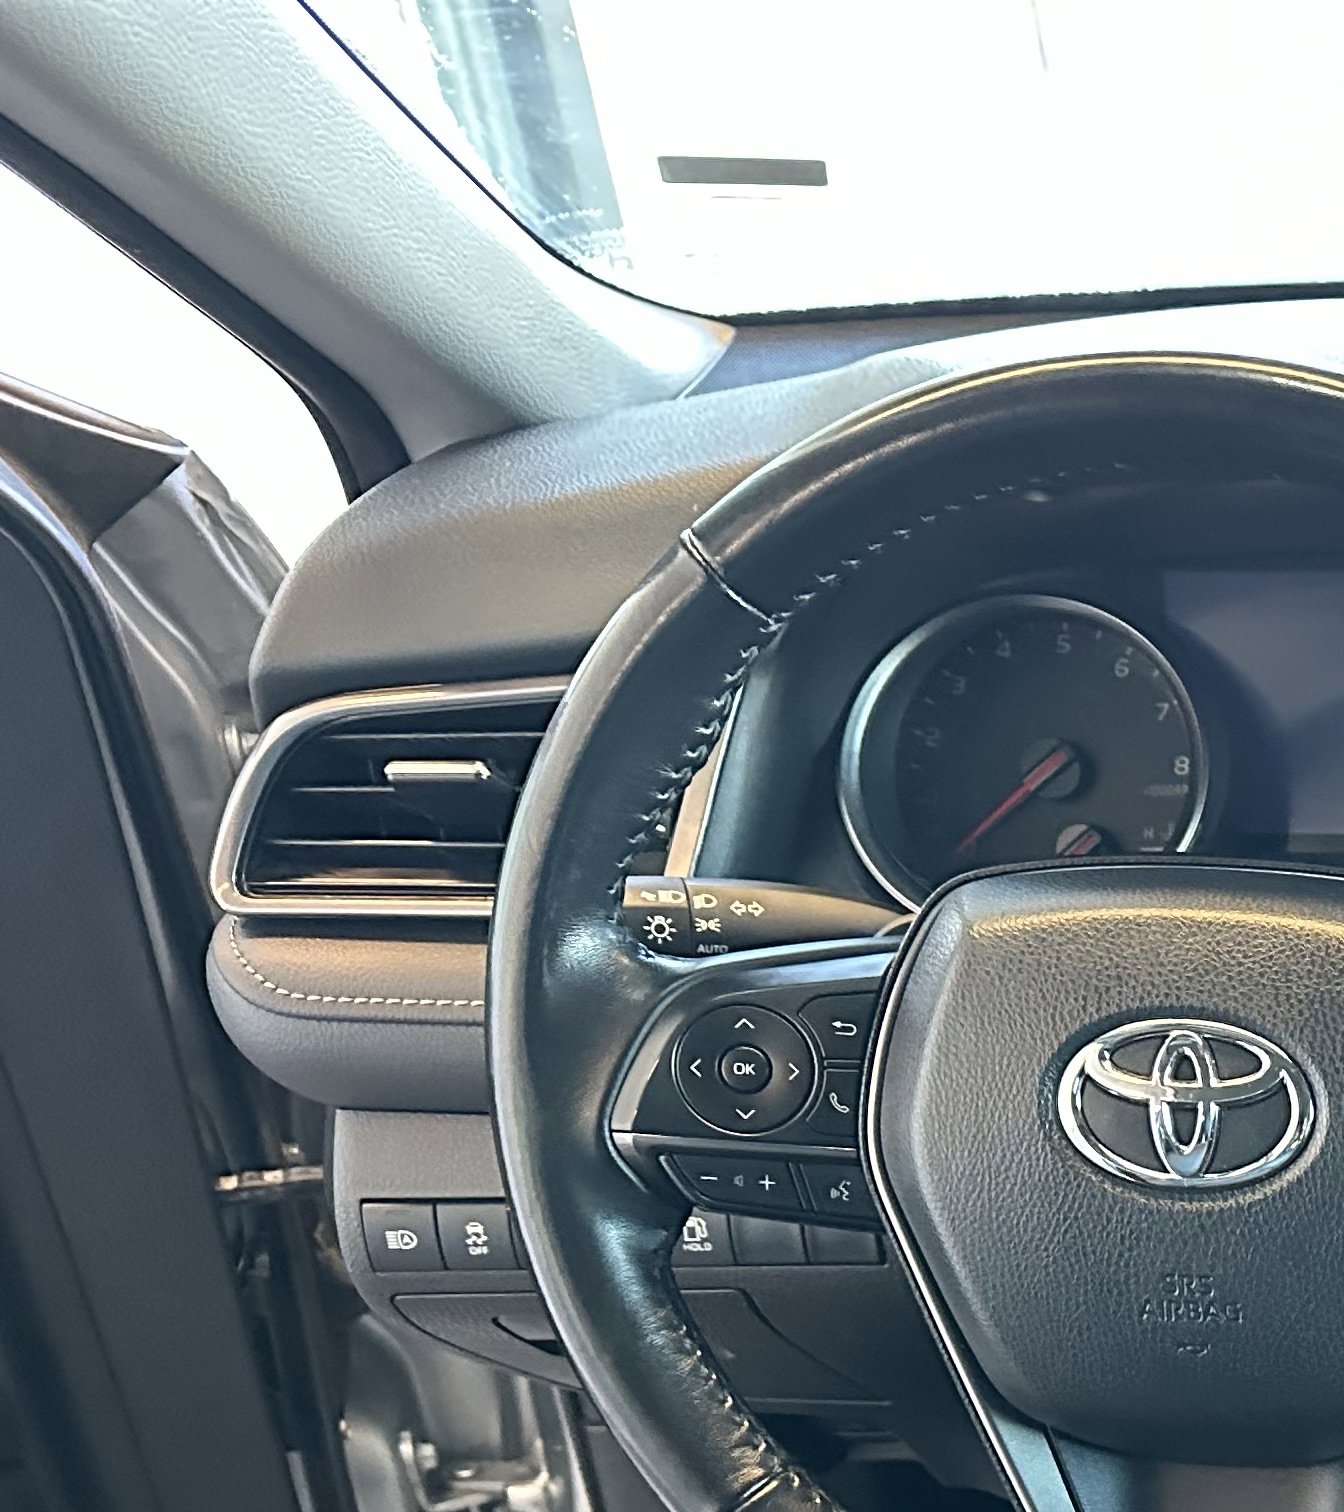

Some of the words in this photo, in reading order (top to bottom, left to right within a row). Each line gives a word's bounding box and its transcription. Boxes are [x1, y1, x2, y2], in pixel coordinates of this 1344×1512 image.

[1056, 634, 1072, 653] 5
[1113, 657, 1131, 678] 6
[1155, 702, 1171, 722] 7
[1173, 755, 1190, 776] 8
[697, 944, 728, 954] AUTO
[733, 1062, 755, 1076] OK
[468, 1246, 488, 1255] OFF
[683, 1242, 712, 1252] HOLD
[1141, 1299, 1243, 1324] AIRBAG
